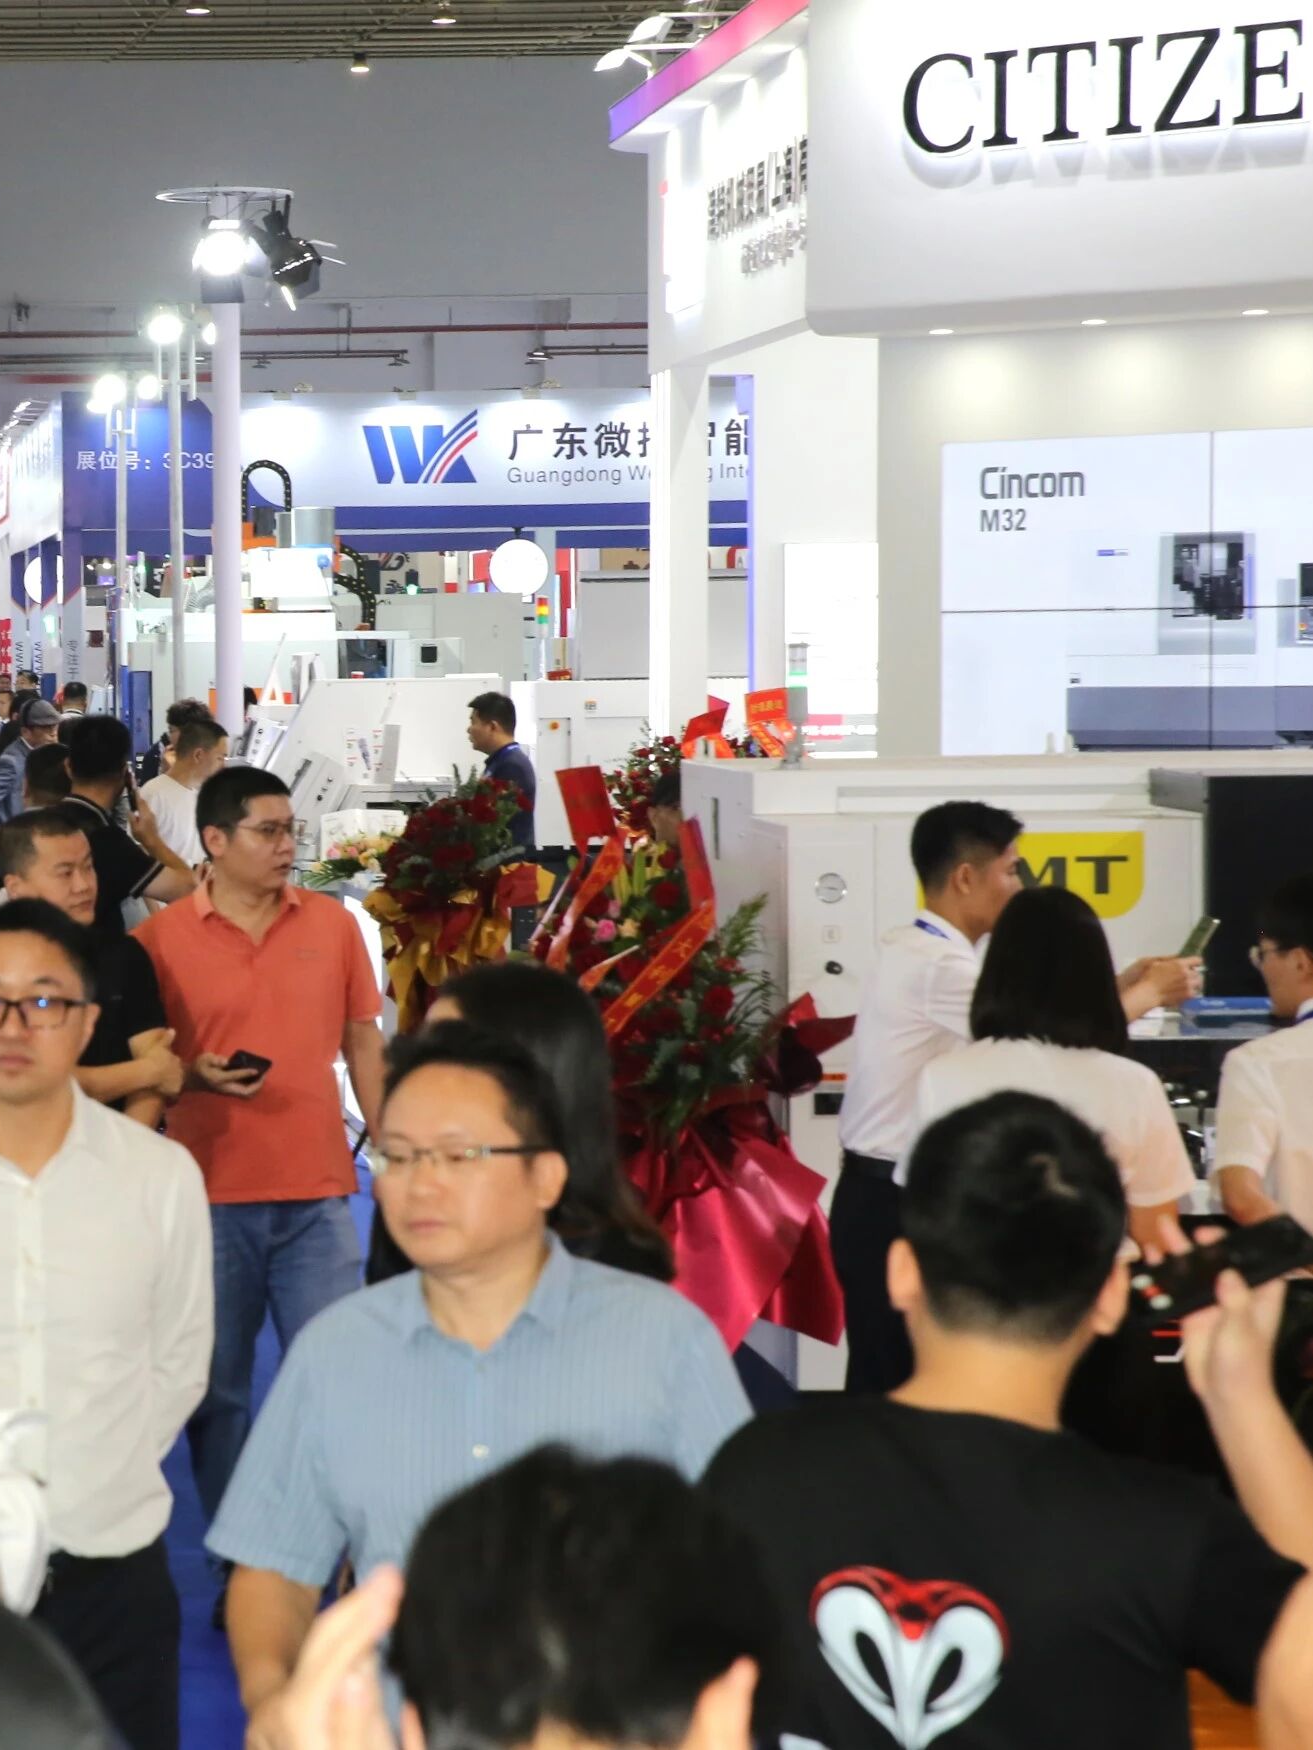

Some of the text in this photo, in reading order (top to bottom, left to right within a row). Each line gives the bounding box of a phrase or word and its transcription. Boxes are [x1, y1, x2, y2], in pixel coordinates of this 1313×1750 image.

[903, 19, 1303, 154] CITIZE
[507, 466, 622, 487] Guangdong
[980, 466, 1085, 499] Cincom
[980, 508, 1027, 532] M32
